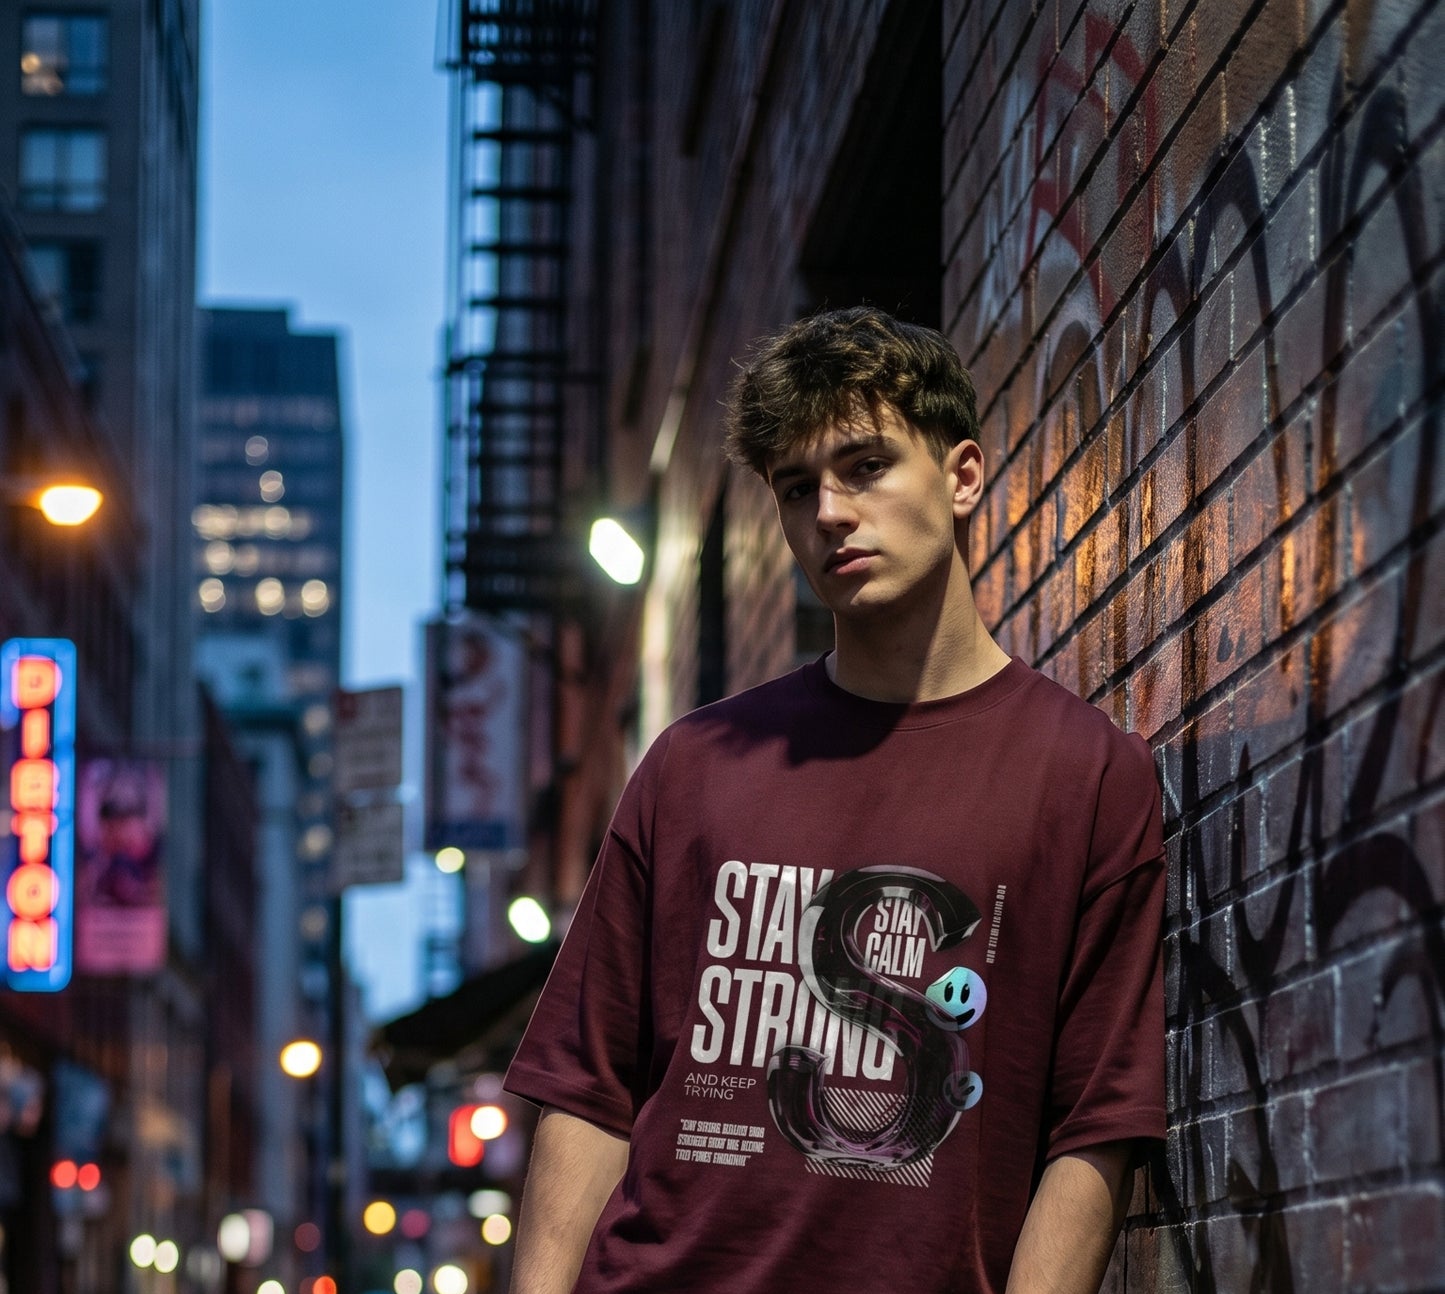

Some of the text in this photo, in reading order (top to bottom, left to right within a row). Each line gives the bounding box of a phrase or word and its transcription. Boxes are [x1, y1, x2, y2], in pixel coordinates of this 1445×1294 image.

[864, 932, 927, 978] CALM
[684, 1072, 757, 1090] AND KEEP
[683, 1084, 734, 1101] TRYING
